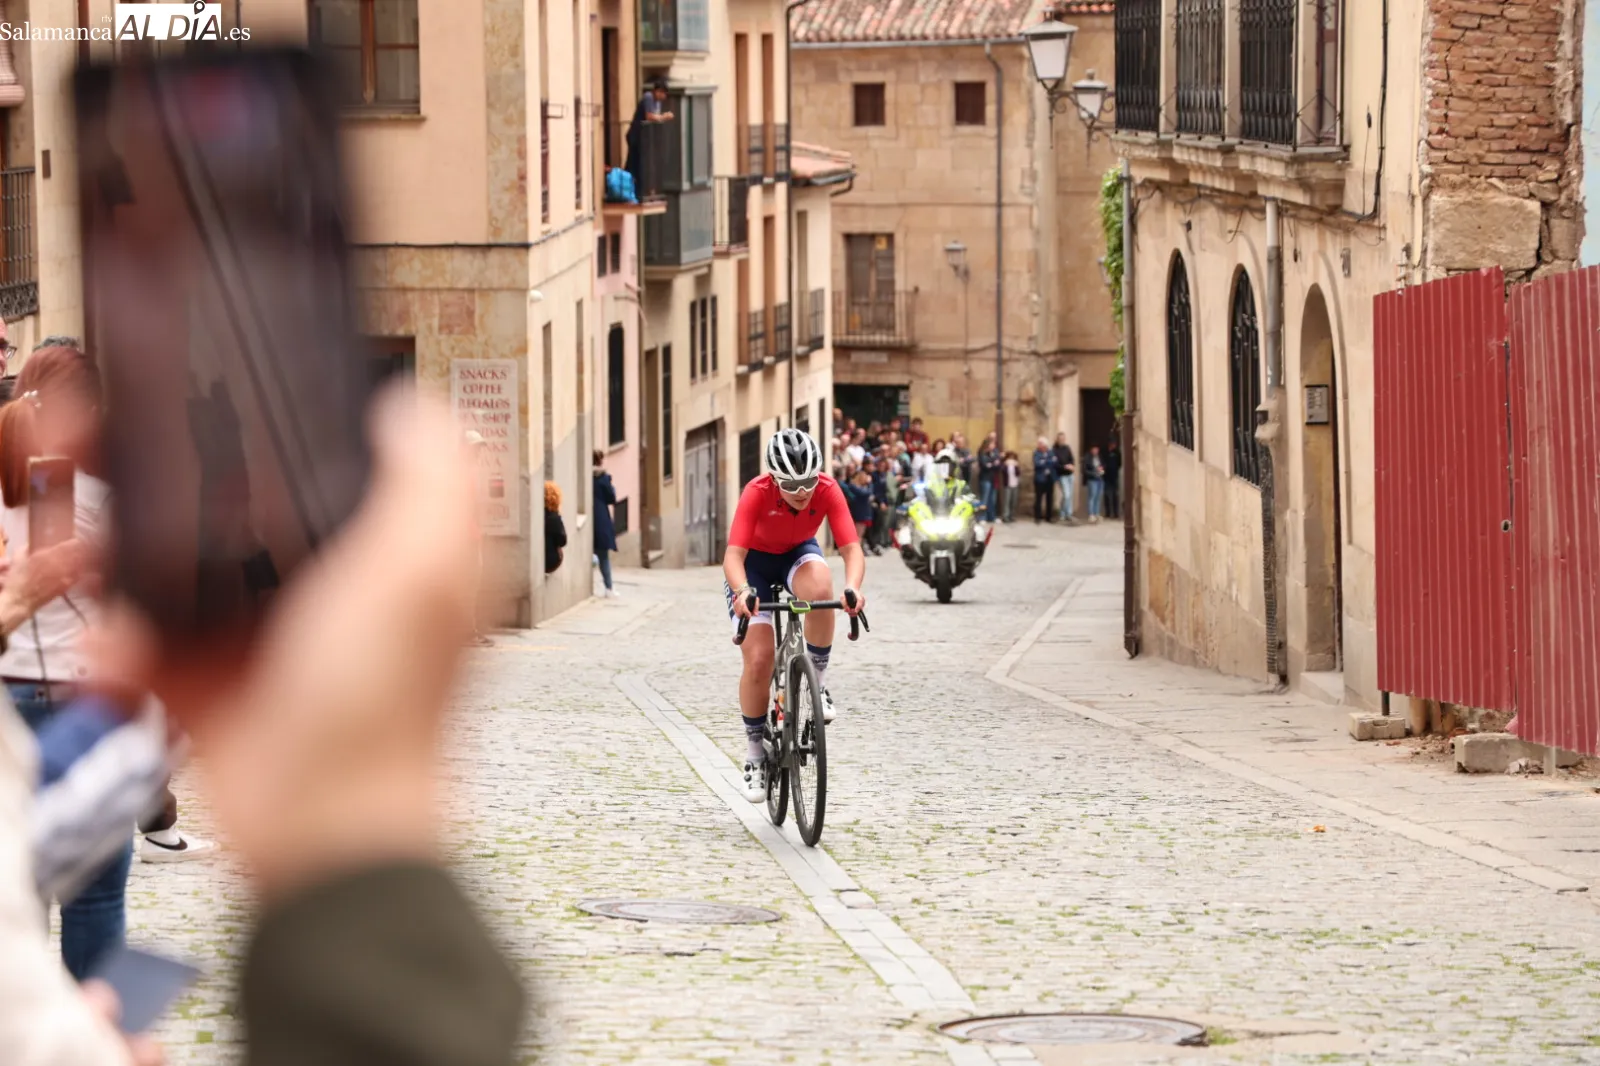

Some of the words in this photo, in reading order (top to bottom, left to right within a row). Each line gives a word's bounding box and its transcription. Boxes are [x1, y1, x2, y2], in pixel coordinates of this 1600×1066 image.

[459, 368, 508, 380] SNACKS
[462, 383, 503, 395] COFFEE
[482, 412, 511, 424] SHOP
